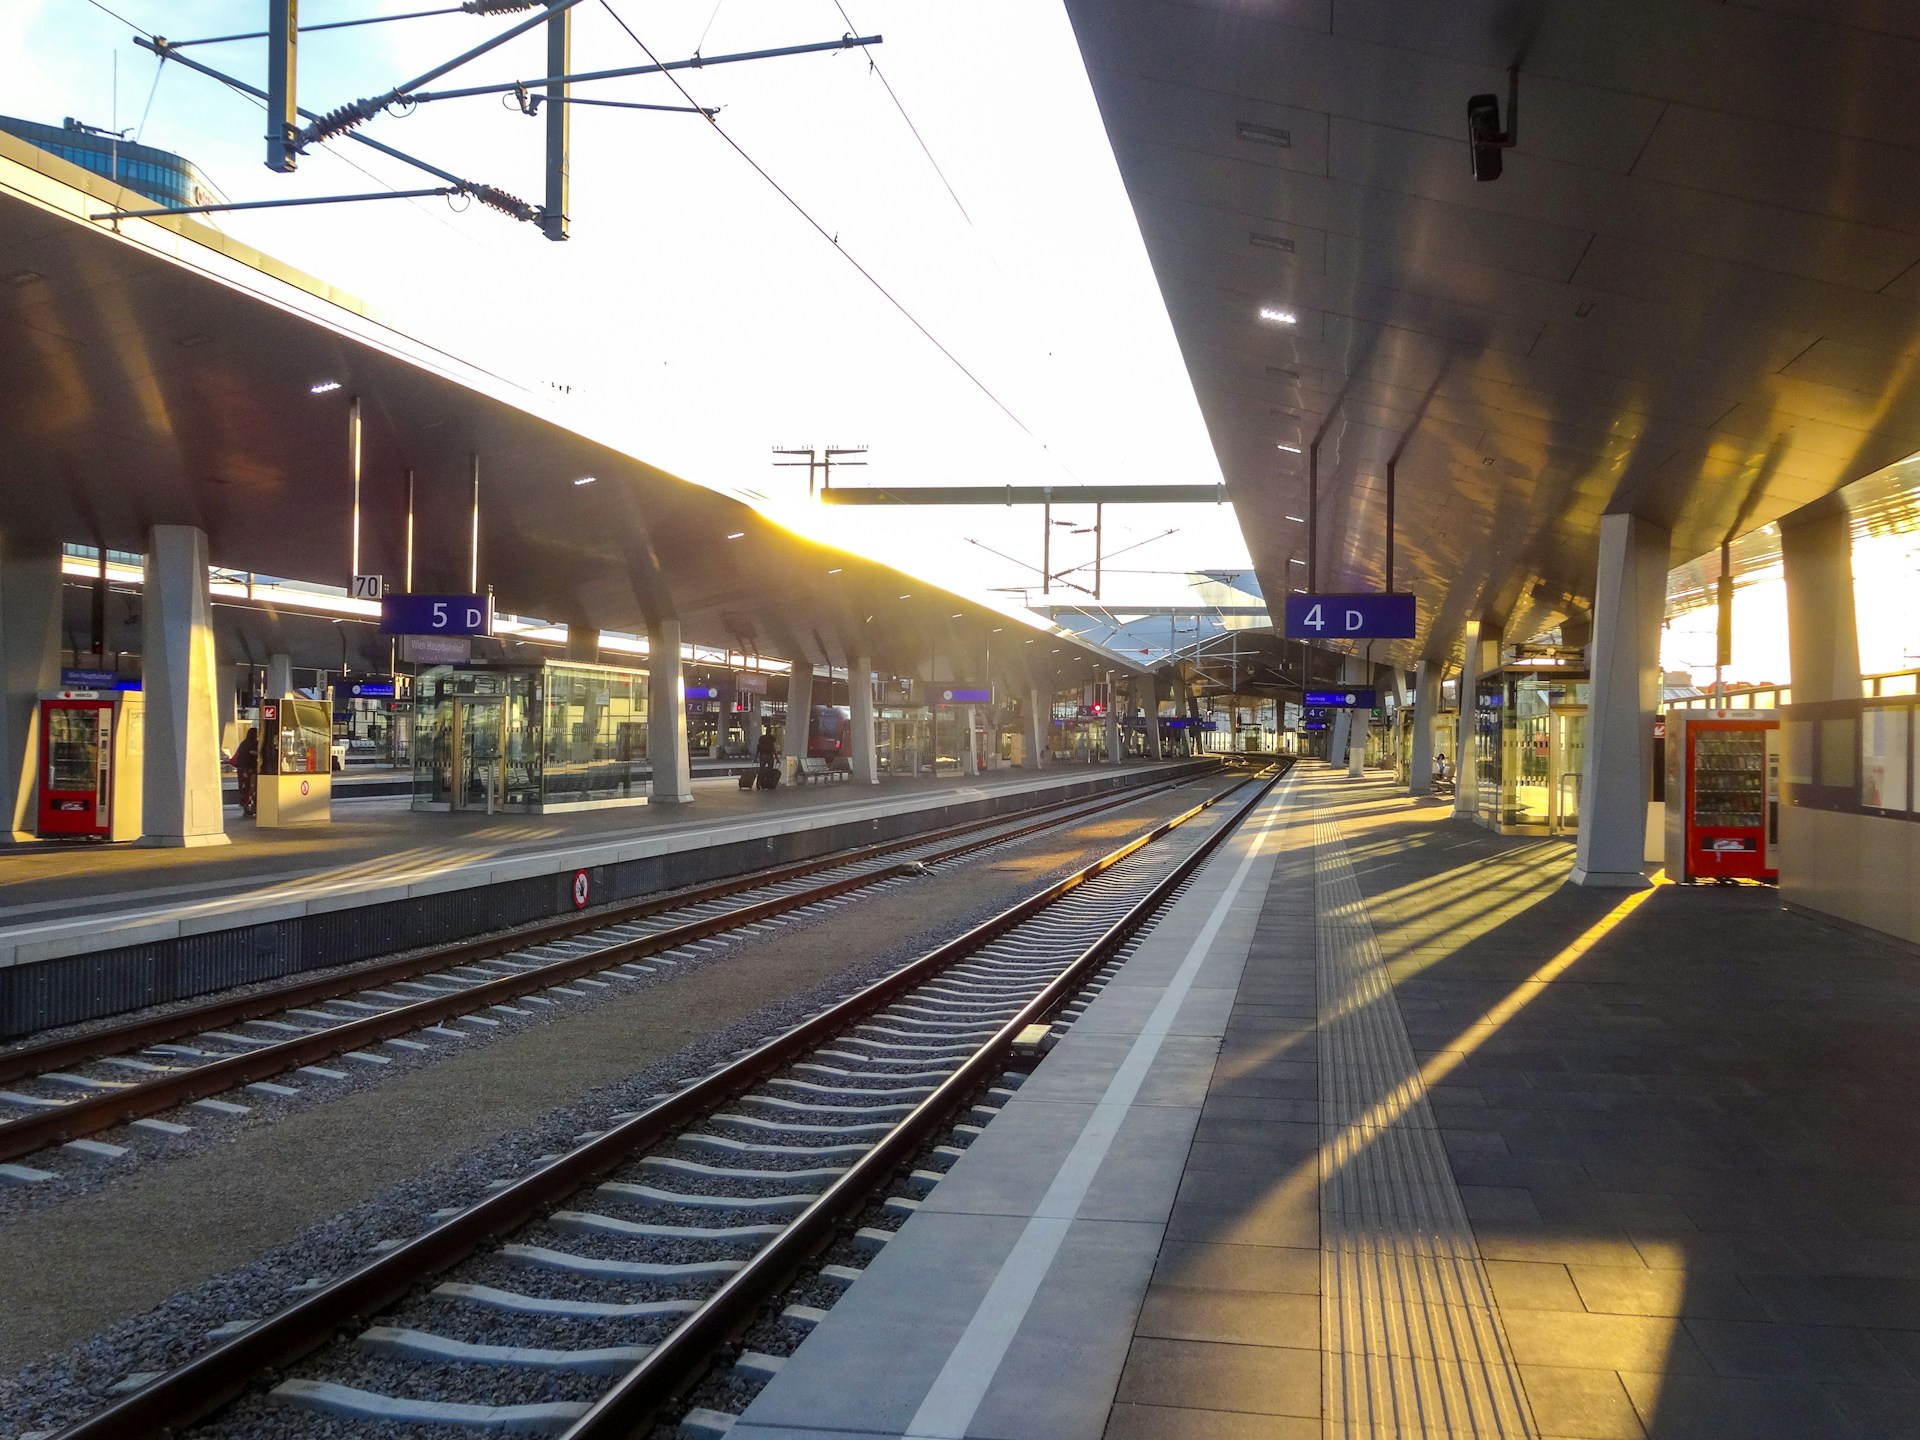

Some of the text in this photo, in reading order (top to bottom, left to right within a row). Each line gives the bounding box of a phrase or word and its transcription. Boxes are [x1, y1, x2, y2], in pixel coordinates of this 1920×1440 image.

[356, 577, 378, 597] 70
[432, 602, 482, 628] 5 D
[1303, 603, 1363, 631] 4 D
